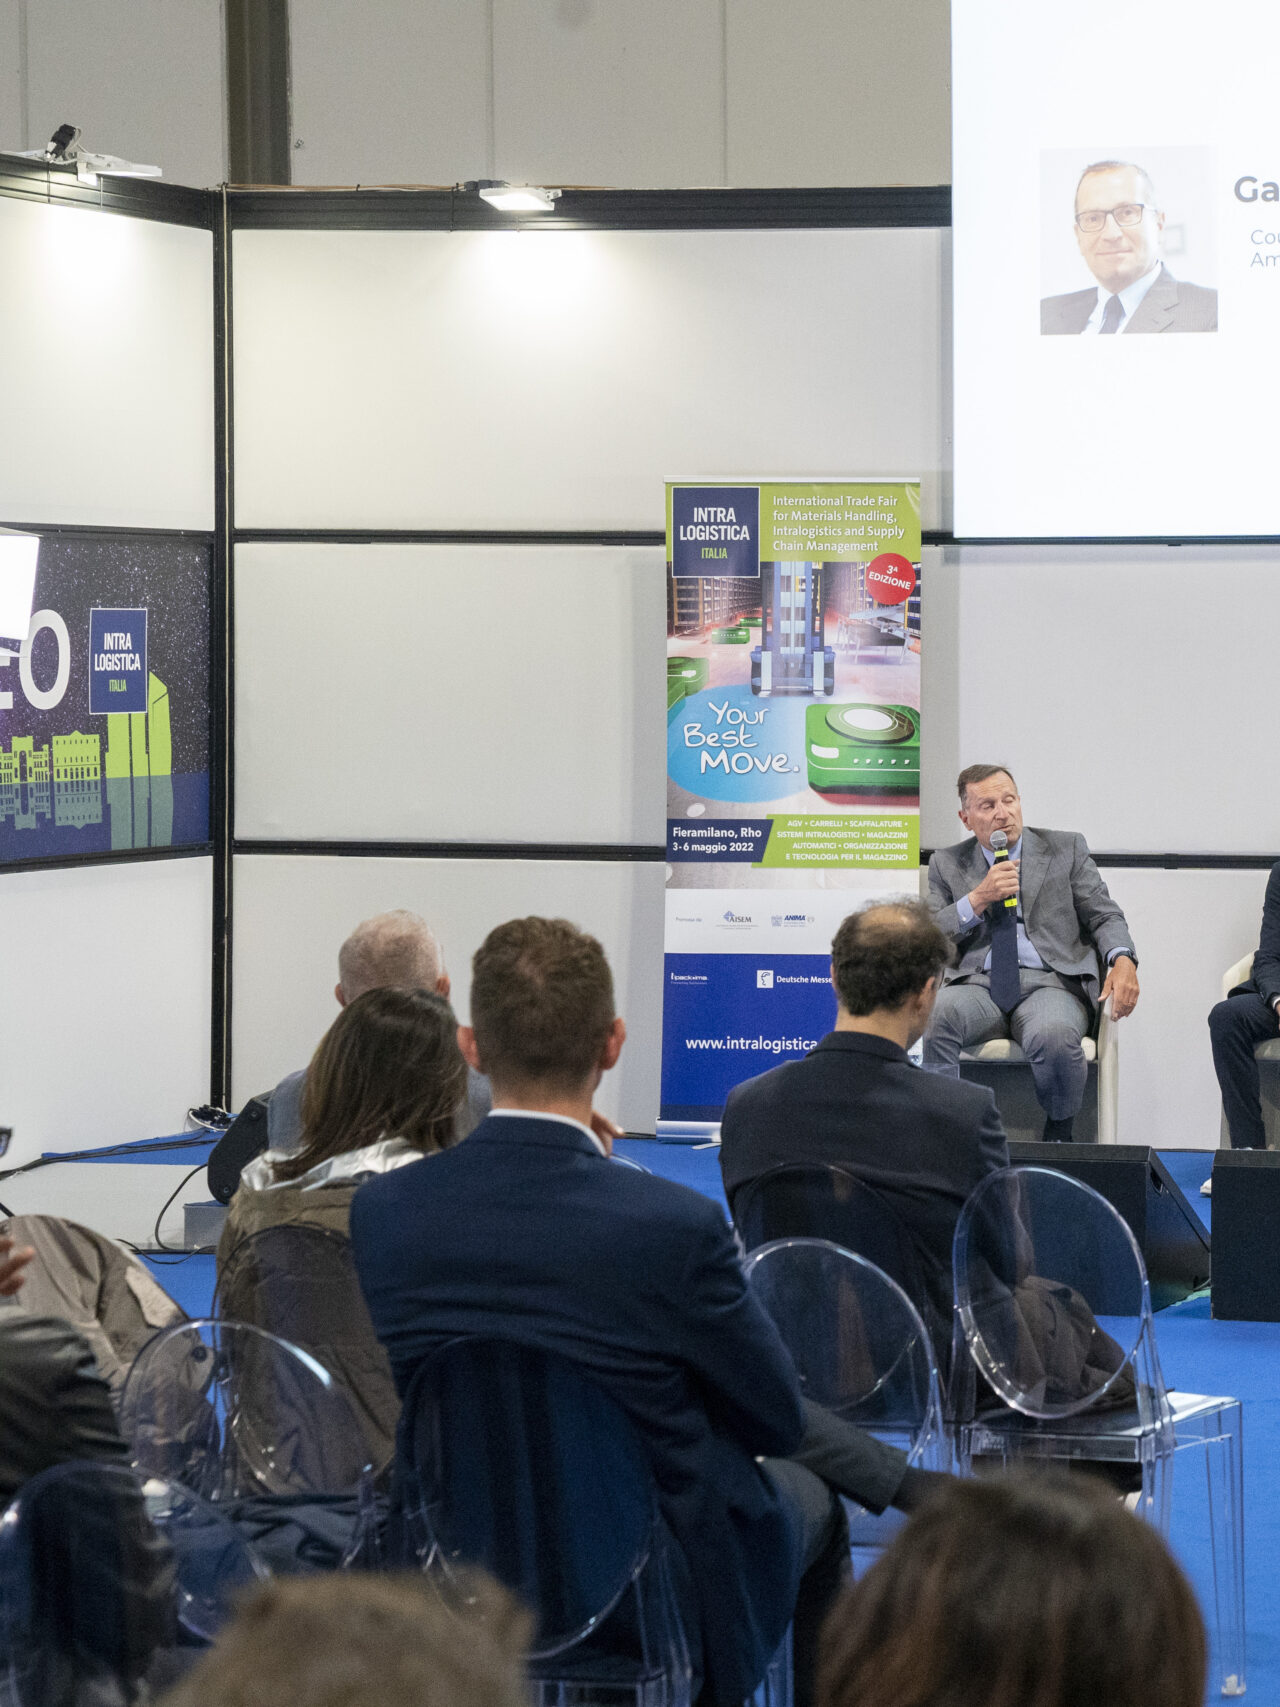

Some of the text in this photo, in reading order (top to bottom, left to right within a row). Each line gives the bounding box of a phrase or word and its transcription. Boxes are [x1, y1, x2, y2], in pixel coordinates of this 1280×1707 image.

[773, 495, 898, 507] International Trade Fair
[693, 506, 737, 523] INTRA
[773, 510, 898, 525] for Materials Handling,
[679, 524, 750, 542] LOGISTICA
[773, 525, 905, 540] Intralogistics and Supply
[701, 547, 728, 560] ITALIA
[773, 540, 879, 555] Chain Management
[868, 571, 912, 591] EDIZIONE
[104, 632, 132, 651] INTRA
[94, 653, 141, 672] LOGISTICA
[108, 679, 128, 693] ITALIA
[708, 700, 770, 726] Your
[683, 722, 759, 748] Best
[849, 820, 903, 828] SCAFFALATURE
[672, 827, 762, 840] Fieramilano, Rho
[776, 831, 908, 839] SISTEMI INTRALOGISTICI MAGAZZINI
[691, 842, 728, 855] maggio
[729, 842, 754, 852] 2022
[792, 842, 908, 850] AUTOMATICI ORGANIZZAZIONE
[792, 853, 839, 861] TECNOLOGIA
[841, 853, 854, 861] PER
[863, 853, 908, 861] MAGAZZINO
[729, 915, 752, 923] AISEM
[776, 975, 832, 984] Deutsche Messe
